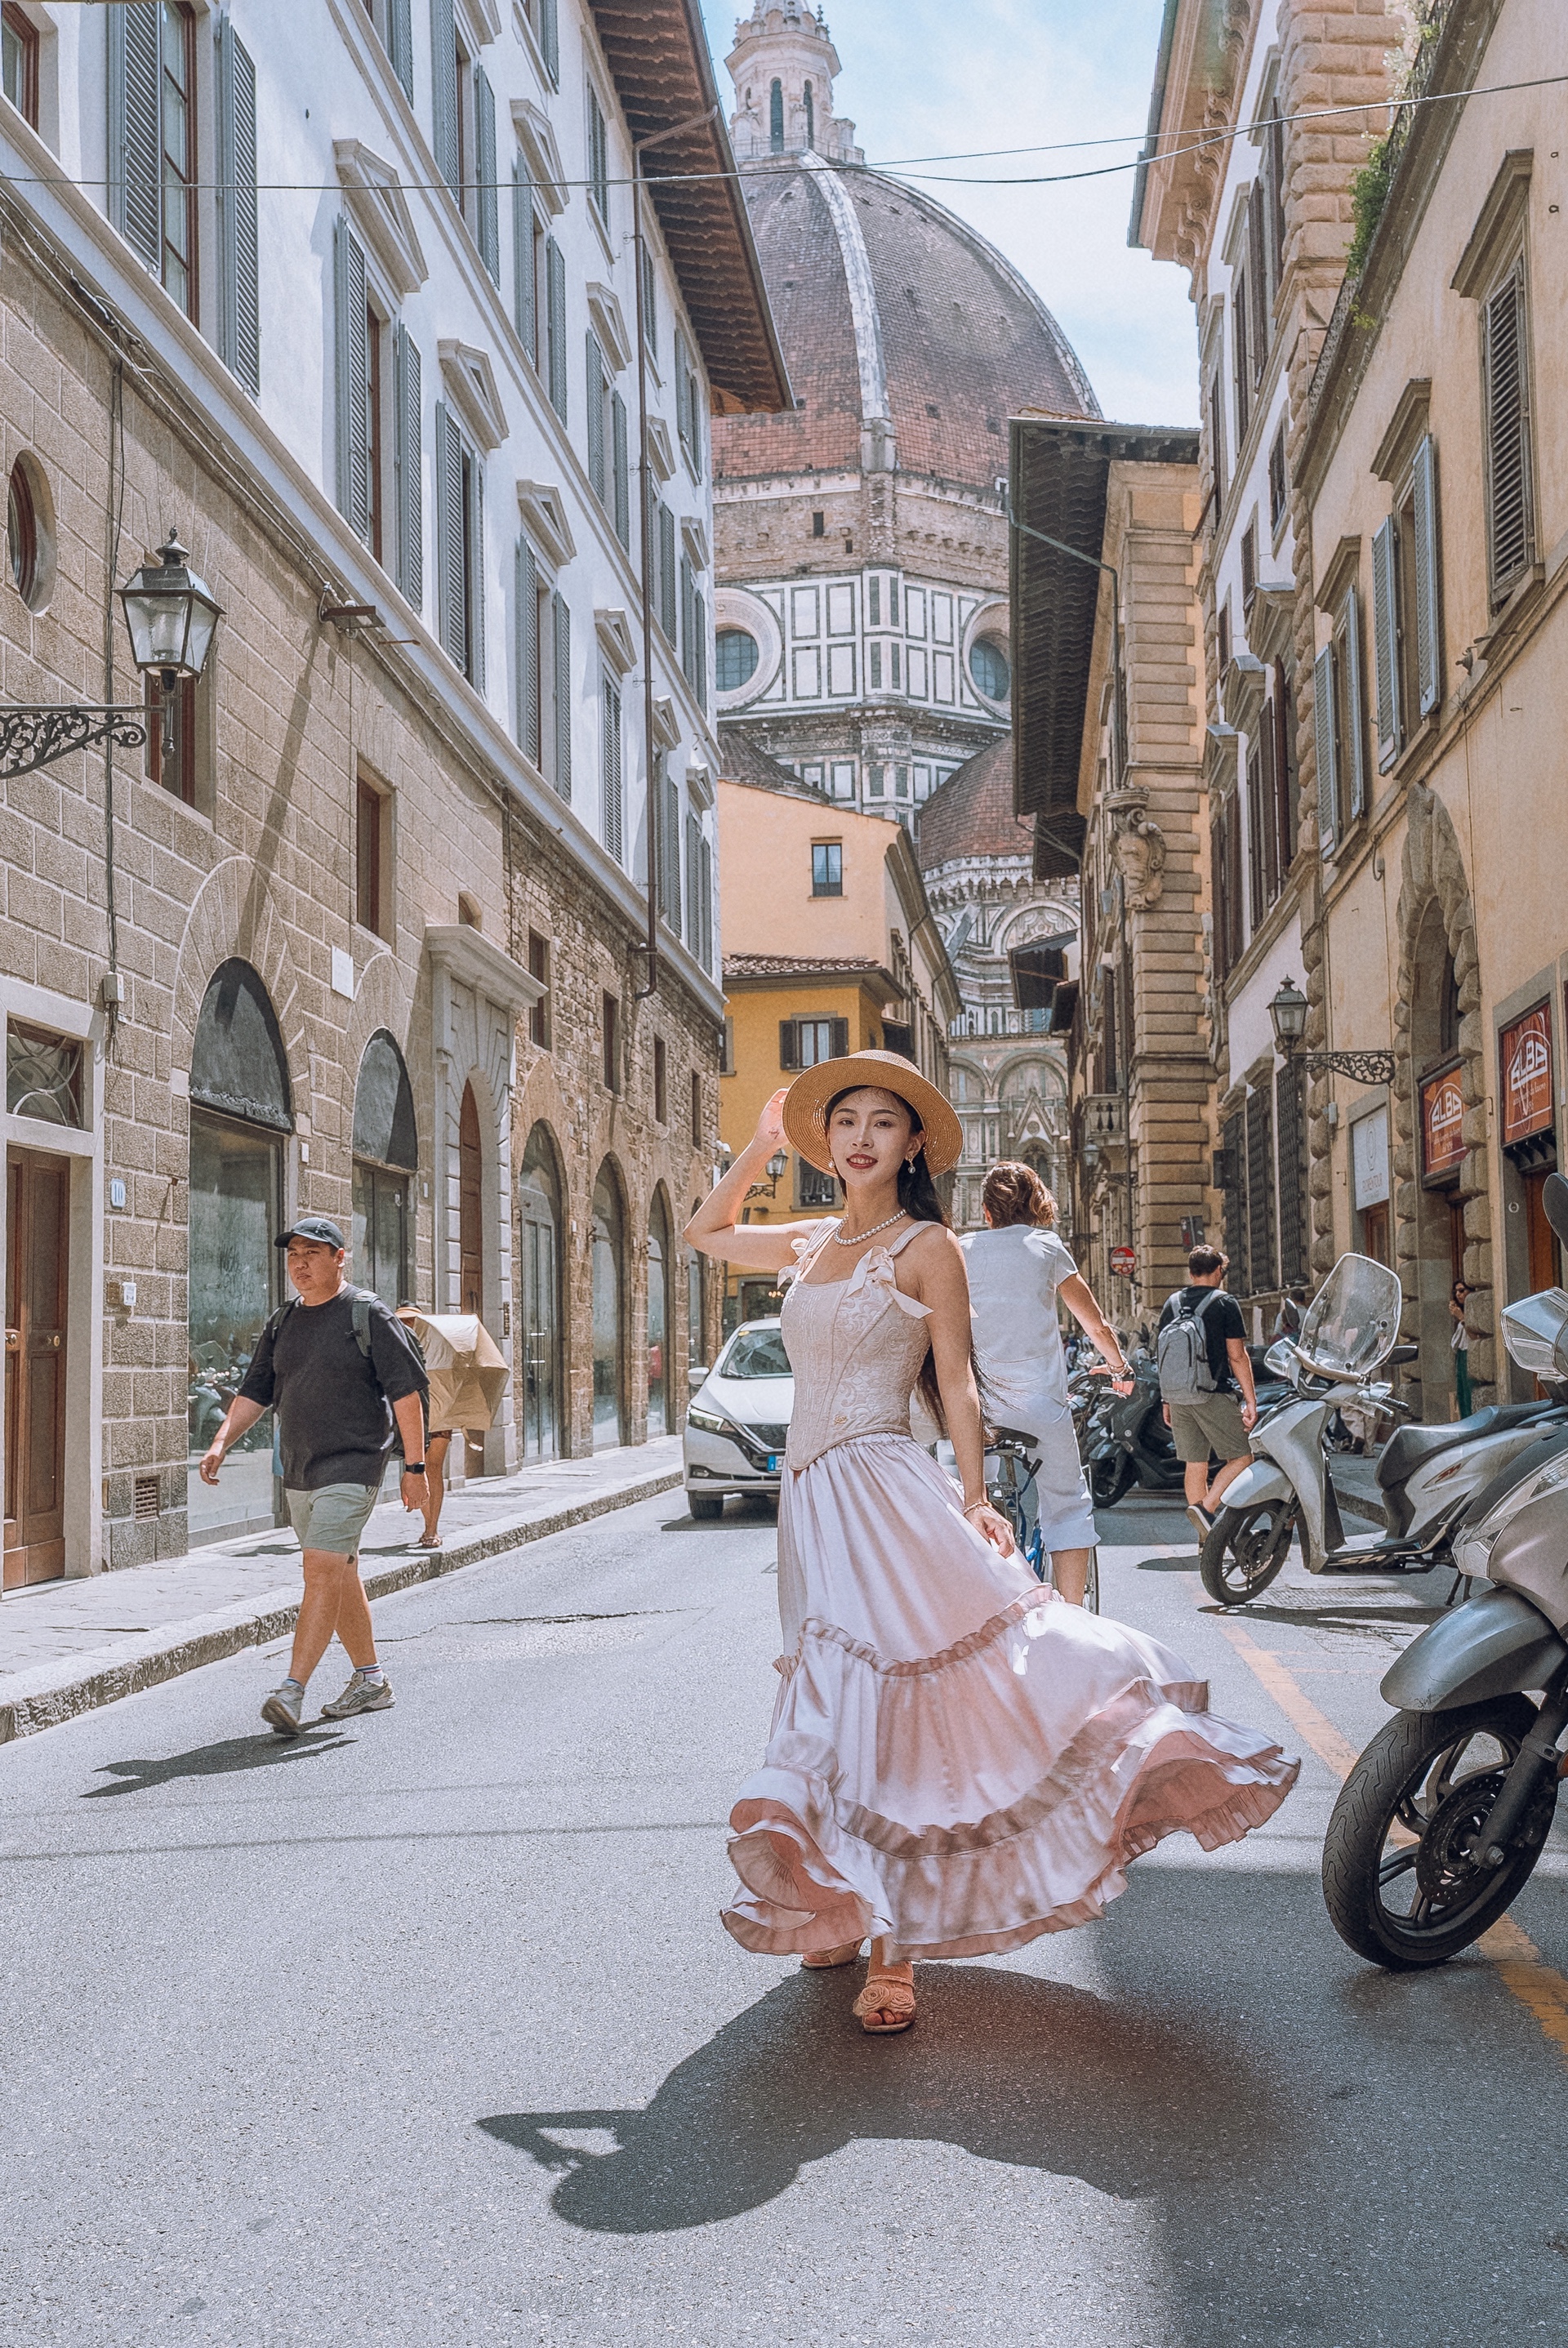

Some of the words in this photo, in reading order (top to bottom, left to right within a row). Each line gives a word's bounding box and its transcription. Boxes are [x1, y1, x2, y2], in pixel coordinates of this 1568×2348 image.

[1512, 1040, 1547, 1080] ALBA
[1432, 1091, 1463, 1124] ALBA
[114, 1183, 123, 1204] 10
